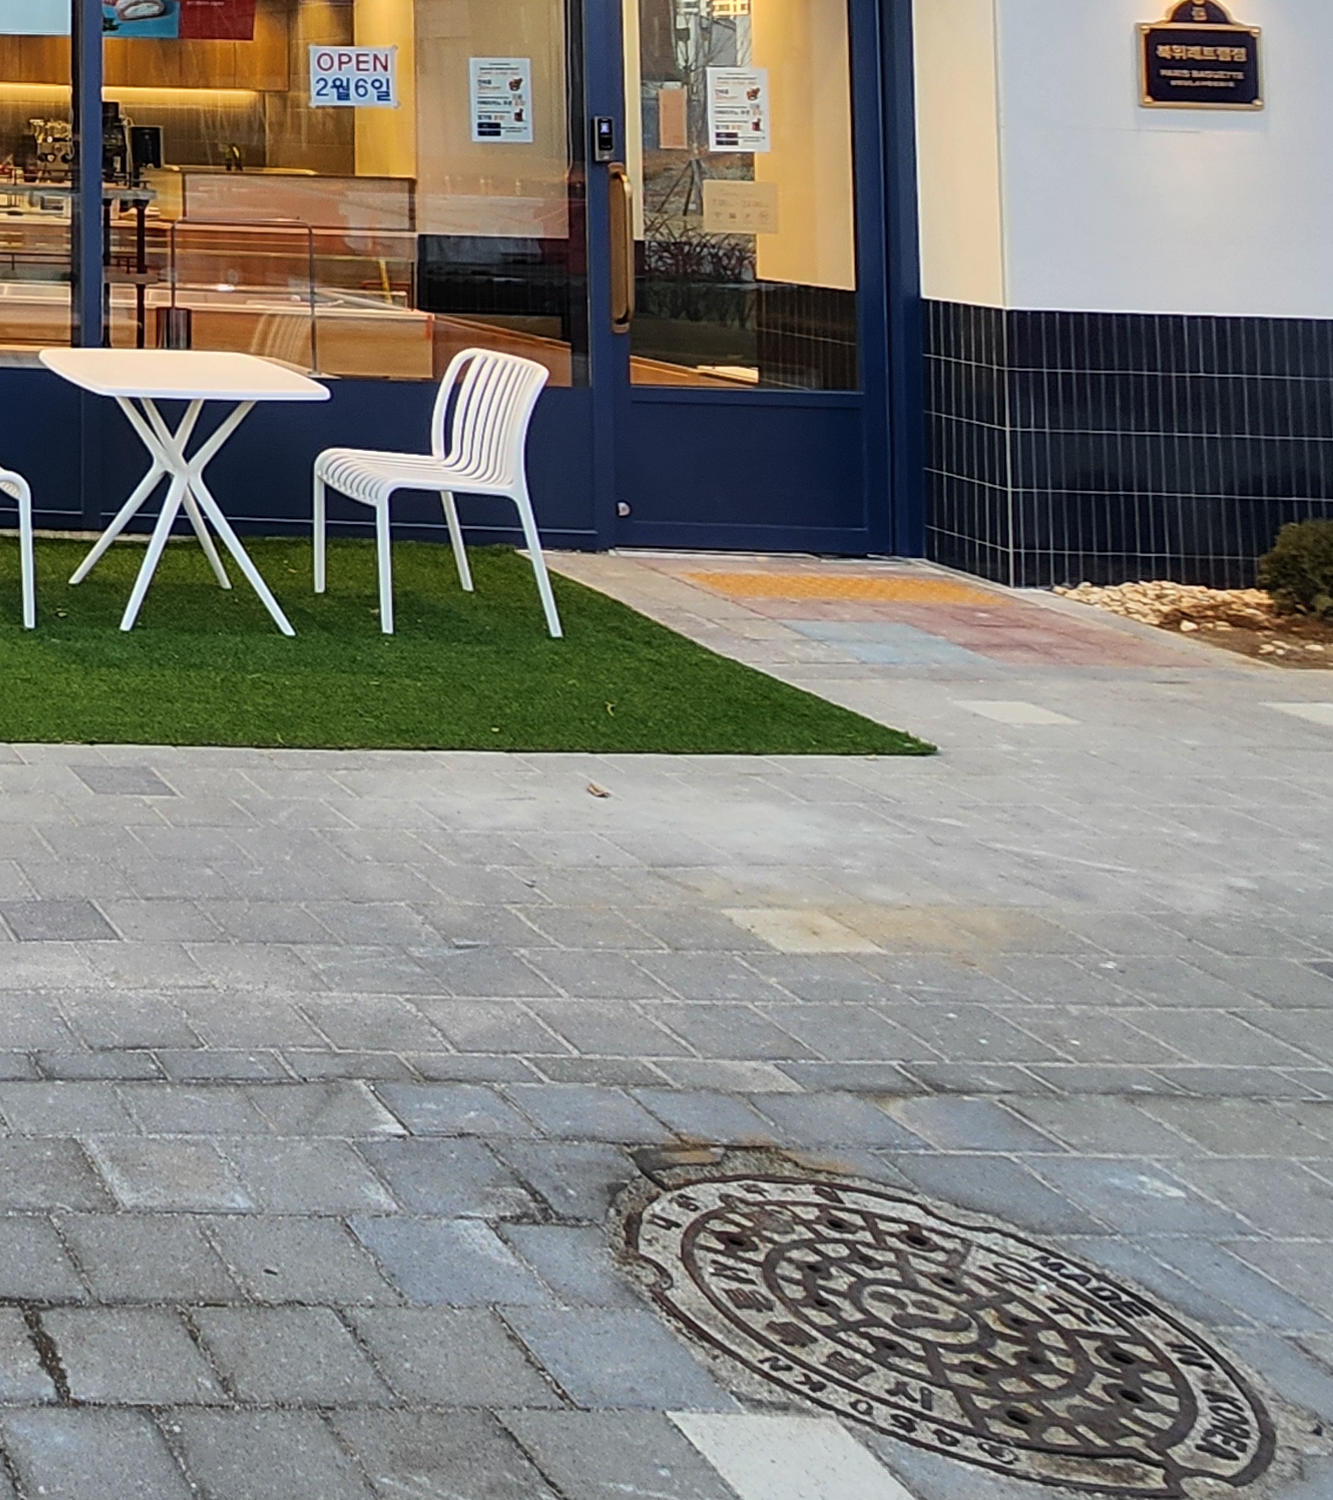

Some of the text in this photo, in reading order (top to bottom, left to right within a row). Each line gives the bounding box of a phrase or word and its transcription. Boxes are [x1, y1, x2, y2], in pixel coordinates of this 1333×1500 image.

[316, 52, 389, 72] OPEN
[1032, 1255, 1252, 1462] MADE IN KOREA
